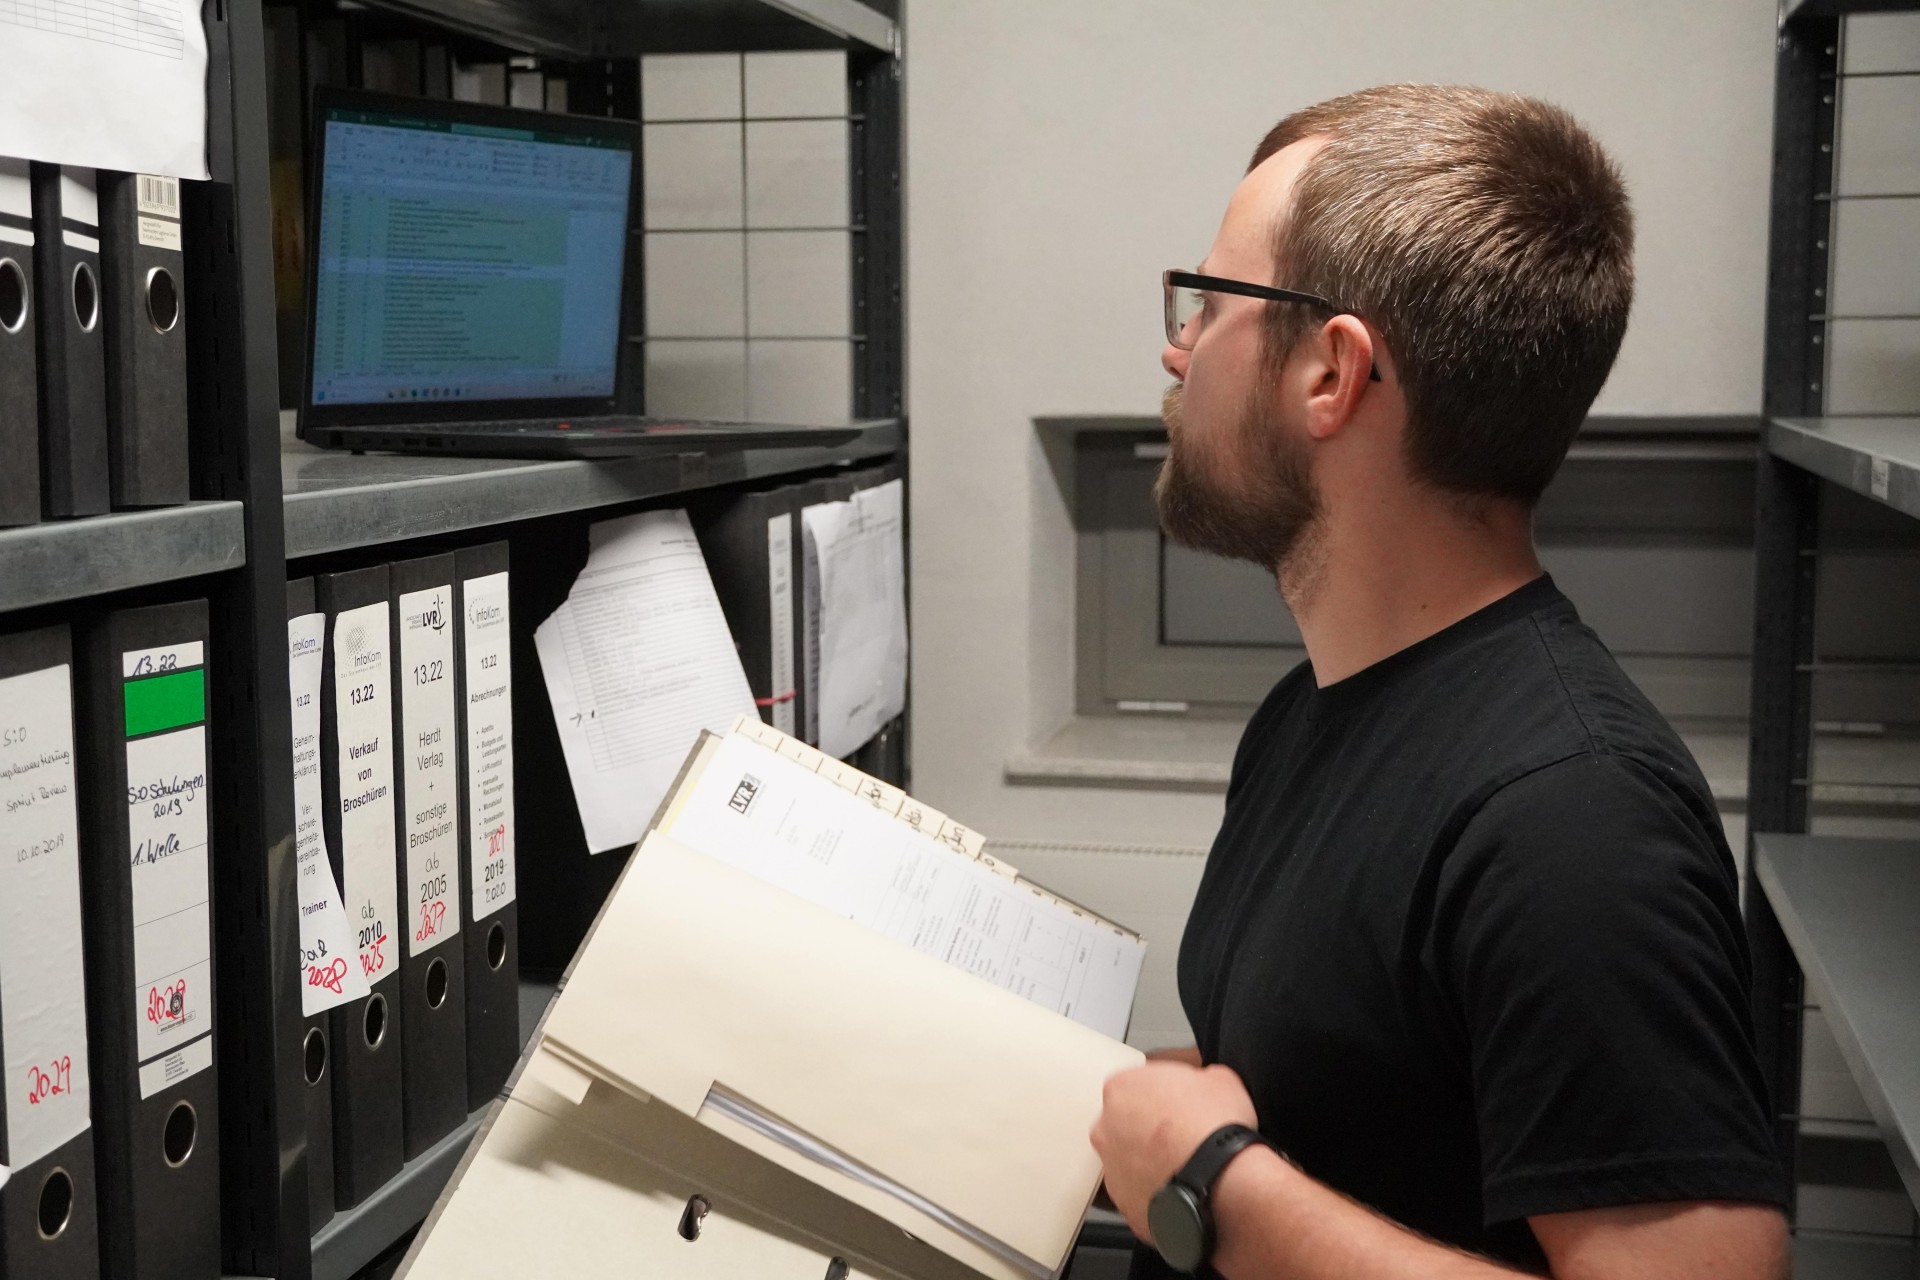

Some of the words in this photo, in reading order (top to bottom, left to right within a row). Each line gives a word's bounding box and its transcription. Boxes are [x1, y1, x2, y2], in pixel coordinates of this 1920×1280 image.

[422, 610, 438, 627] LVR
[132, 653, 177, 676] 13.22
[354, 651, 382, 667] InfoKom
[481, 654, 498, 670] 13.22
[414, 660, 443, 686] 13.22
[296, 693, 311, 708] 13.22
[350, 683, 374, 706] 13.22
[470, 684, 507, 704] Abrechnungen
[293, 734, 315, 749] Geheim-
[419, 728, 441, 749] Herdt
[293, 749, 317, 764] haltungs-
[349, 738, 379, 761] Verkauf
[293, 763, 317, 780] erklärung
[417, 752, 444, 773] Verlag
[357, 767, 372, 782] von
[429, 781, 434, 791] +
[153, 798, 183, 818] 2019
[343, 784, 387, 813] Broschüren
[415, 802, 447, 825] sonstige
[298, 819, 317, 833] schwie-
[410, 820, 453, 849] Broschüren
[132, 842, 144, 866] 1.
[147, 833, 180, 864] Welle
[303, 864, 316, 877] rung
[425, 851, 440, 873] ab
[420, 873, 447, 904] 2005
[301, 898, 328, 918] Trainer
[361, 898, 375, 919] ab
[358, 920, 382, 949] 2010
[308, 957, 347, 994] 2028
[28, 1055, 71, 1105] 2029
